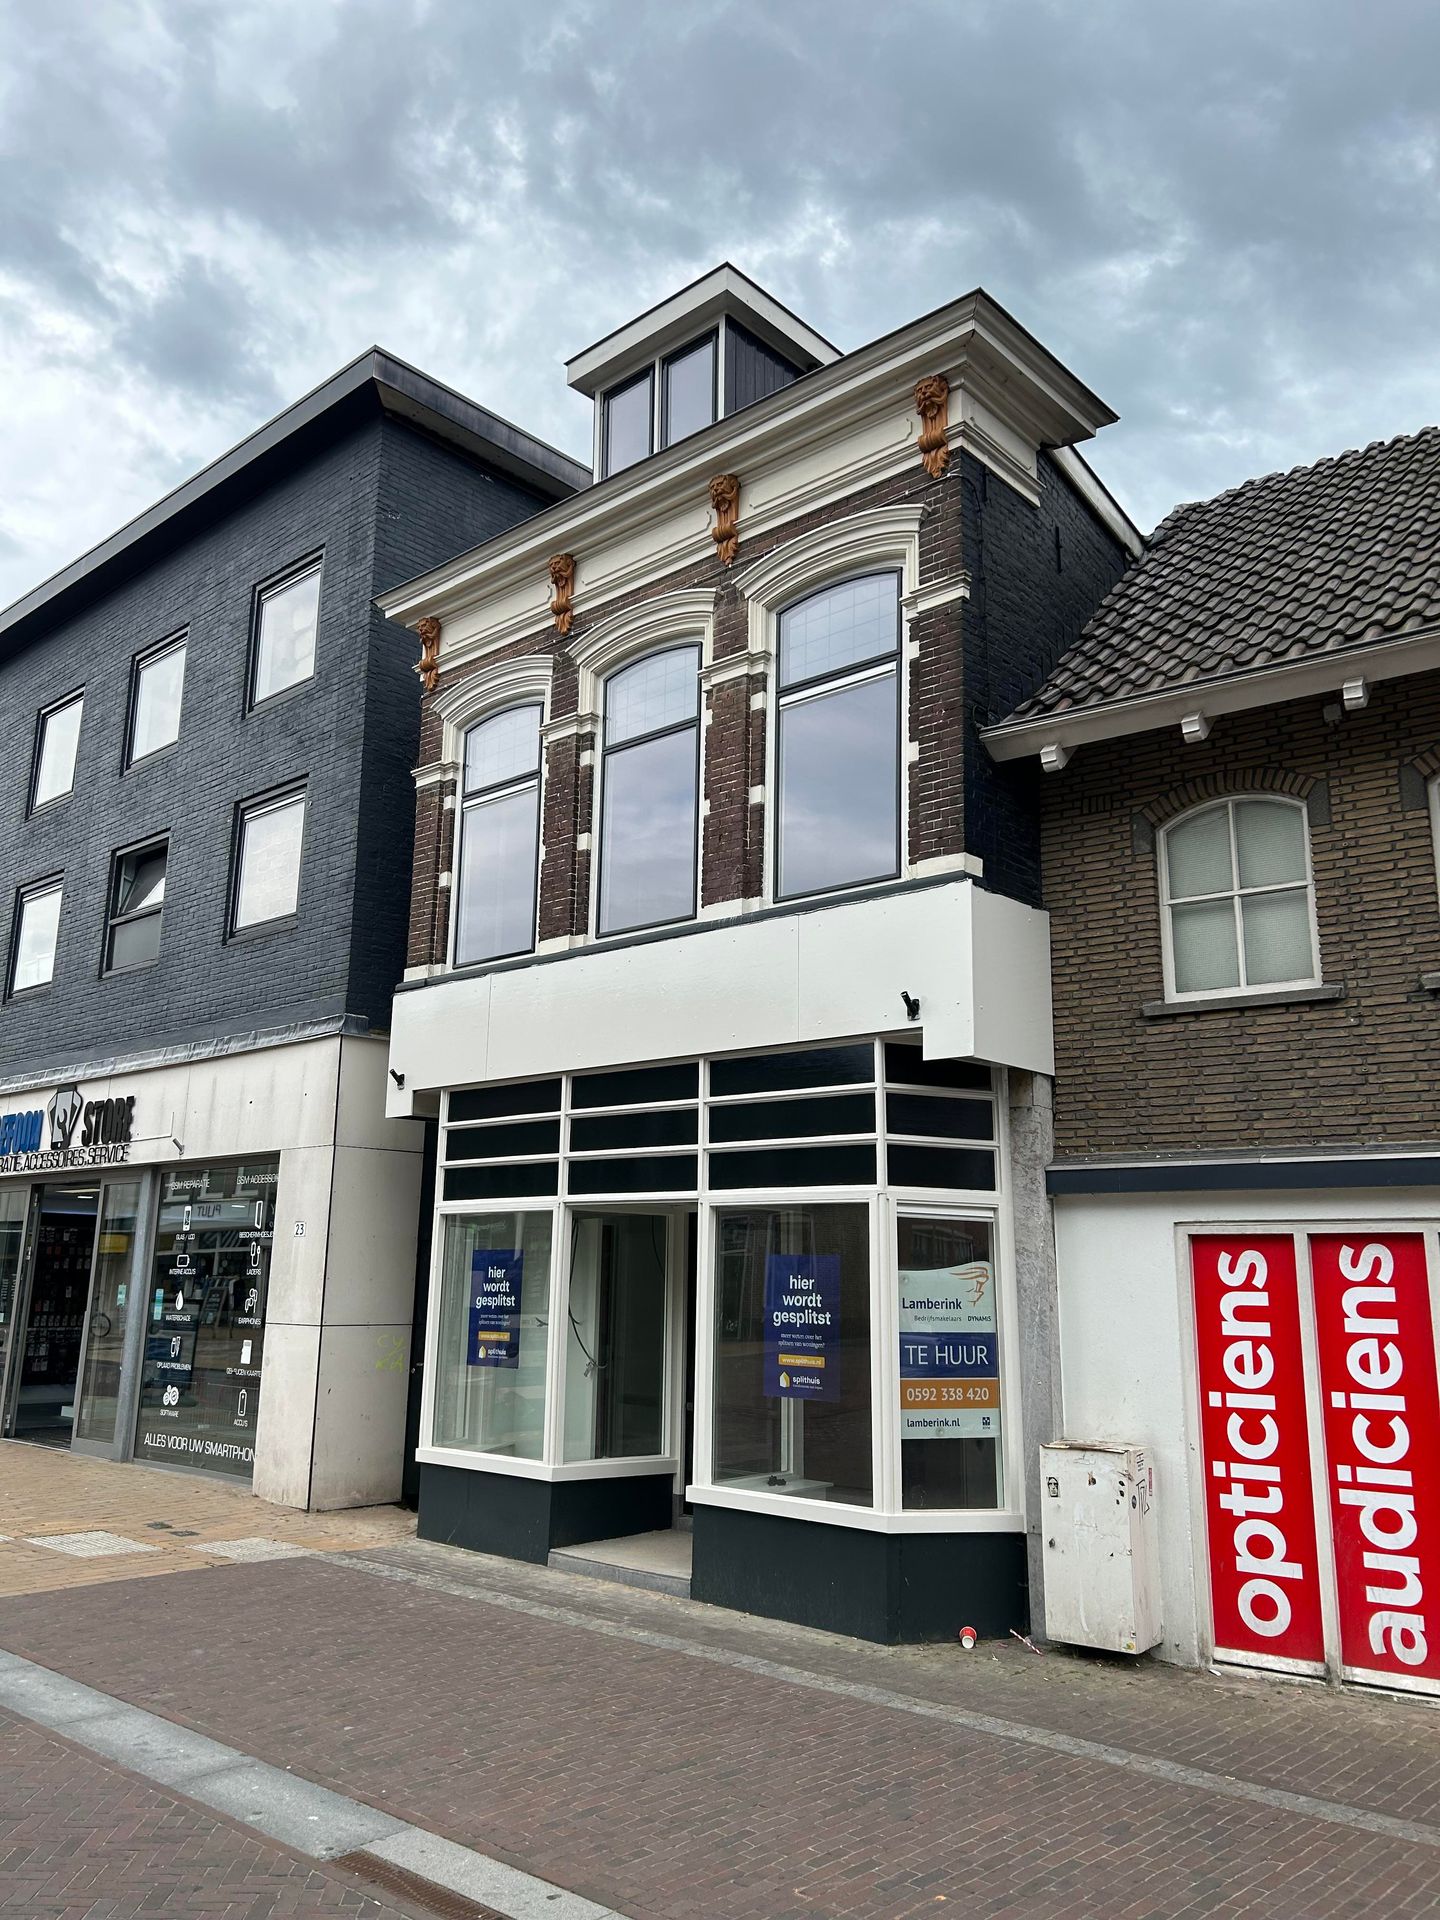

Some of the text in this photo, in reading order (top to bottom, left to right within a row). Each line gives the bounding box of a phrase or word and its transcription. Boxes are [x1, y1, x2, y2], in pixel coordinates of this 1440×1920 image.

[0, 1096, 136, 1156] EFOON STORE
[295, 1223, 304, 1235] 23
[488, 1266, 506, 1278] hier
[482, 1280, 510, 1293] wordt
[790, 1274, 815, 1290] hier
[475, 1294, 516, 1309] gesplitst
[782, 1292, 822, 1307] wordt
[902, 1297, 963, 1310] Lamberink
[238, 1317, 262, 1325] EARPHONES
[773, 1309, 832, 1328] gesplitst
[914, 1315, 963, 1323] Bedrijfsmakelaars
[904, 1345, 989, 1365] TE HUUR
[792, 1376, 821, 1385] splithuis
[906, 1387, 989, 1401] 0592 338 420
[160, 1409, 180, 1417] SOFTWARE
[906, 1417, 961, 1428] lamberink.nl
[144, 1432, 167, 1448] ALLES
[167, 1436, 188, 1451] VOOR
[188, 1438, 205, 1454] UW
[1208, 1248, 1303, 1638] opticiens
[1330, 1242, 1429, 1667] audiciens
